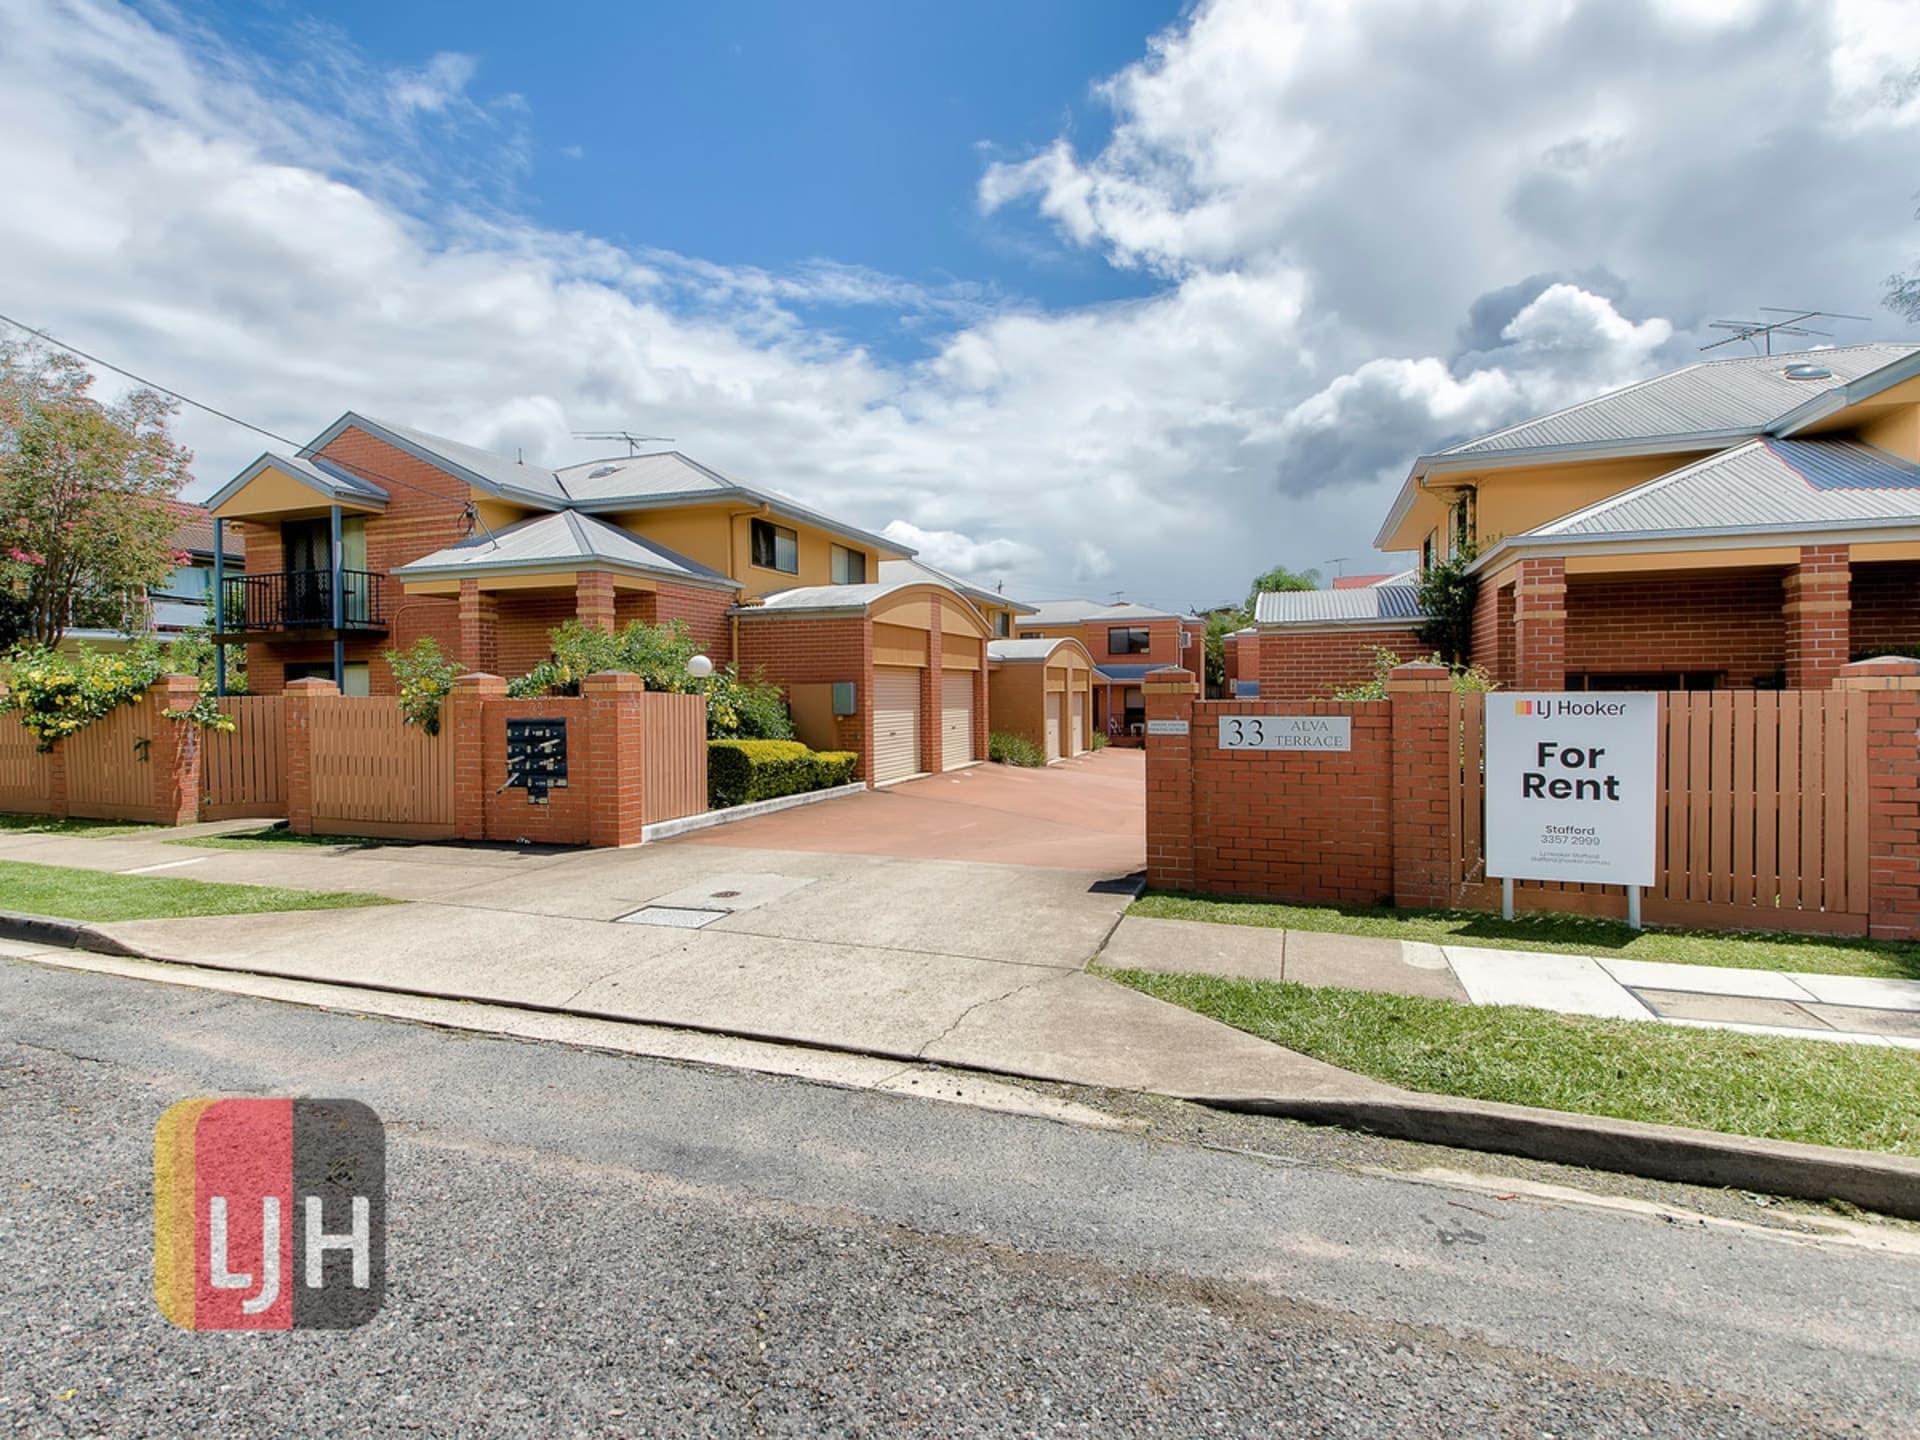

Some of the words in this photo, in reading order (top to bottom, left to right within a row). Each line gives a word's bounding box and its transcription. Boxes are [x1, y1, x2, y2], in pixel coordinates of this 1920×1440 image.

[1536, 700, 1551, 719] LJ
[1557, 700, 1626, 716] Hooker
[1227, 719, 1264, 747] 33
[1290, 720, 1329, 732] ALVA
[1275, 735, 1344, 748] TERRACE
[1537, 741, 1606, 769] For
[1522, 772, 1620, 801] Rent
[1544, 824, 1596, 836] Stafford
[1540, 834, 1569, 845] 3357
